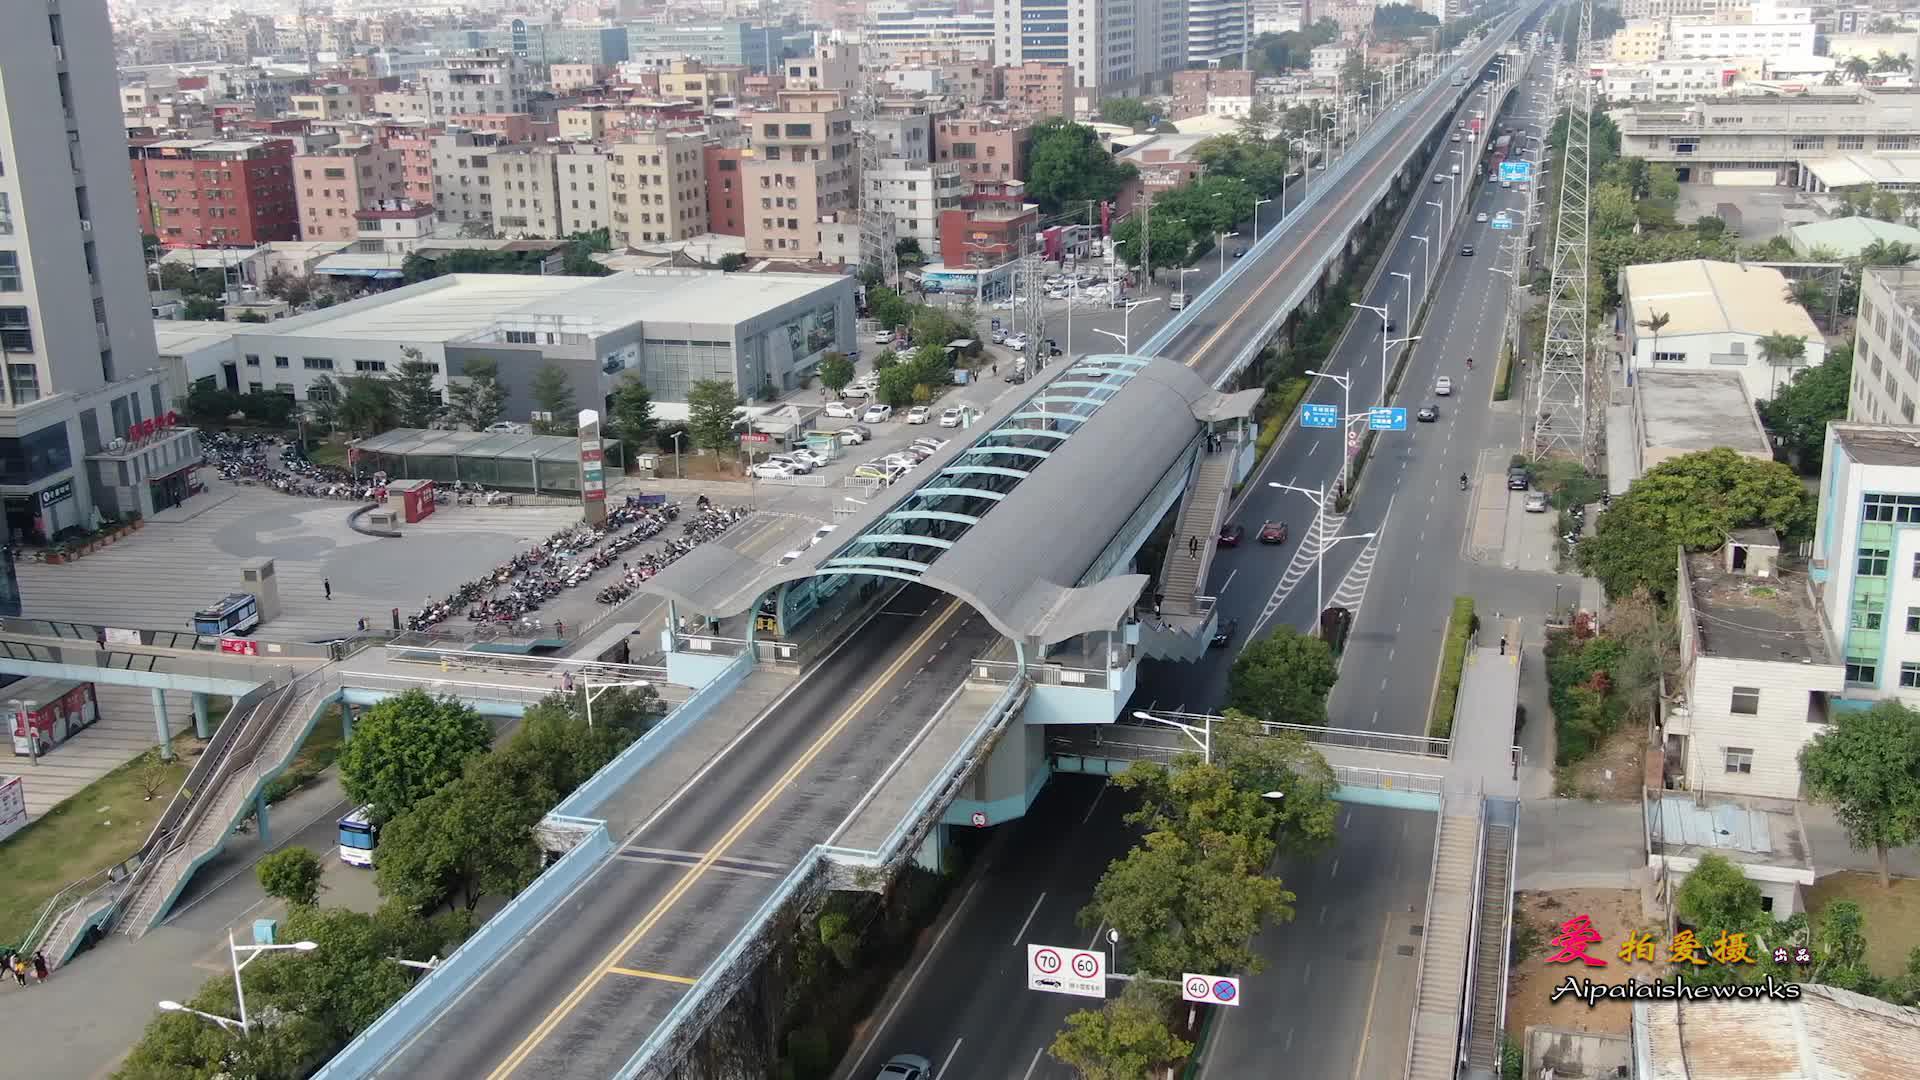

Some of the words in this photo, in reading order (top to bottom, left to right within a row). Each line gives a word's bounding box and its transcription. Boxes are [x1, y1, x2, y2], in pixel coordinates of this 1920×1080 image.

[1040, 955, 1056, 969] 70
[1077, 959, 1093, 972] 60
[1190, 983, 1206, 994] 40
